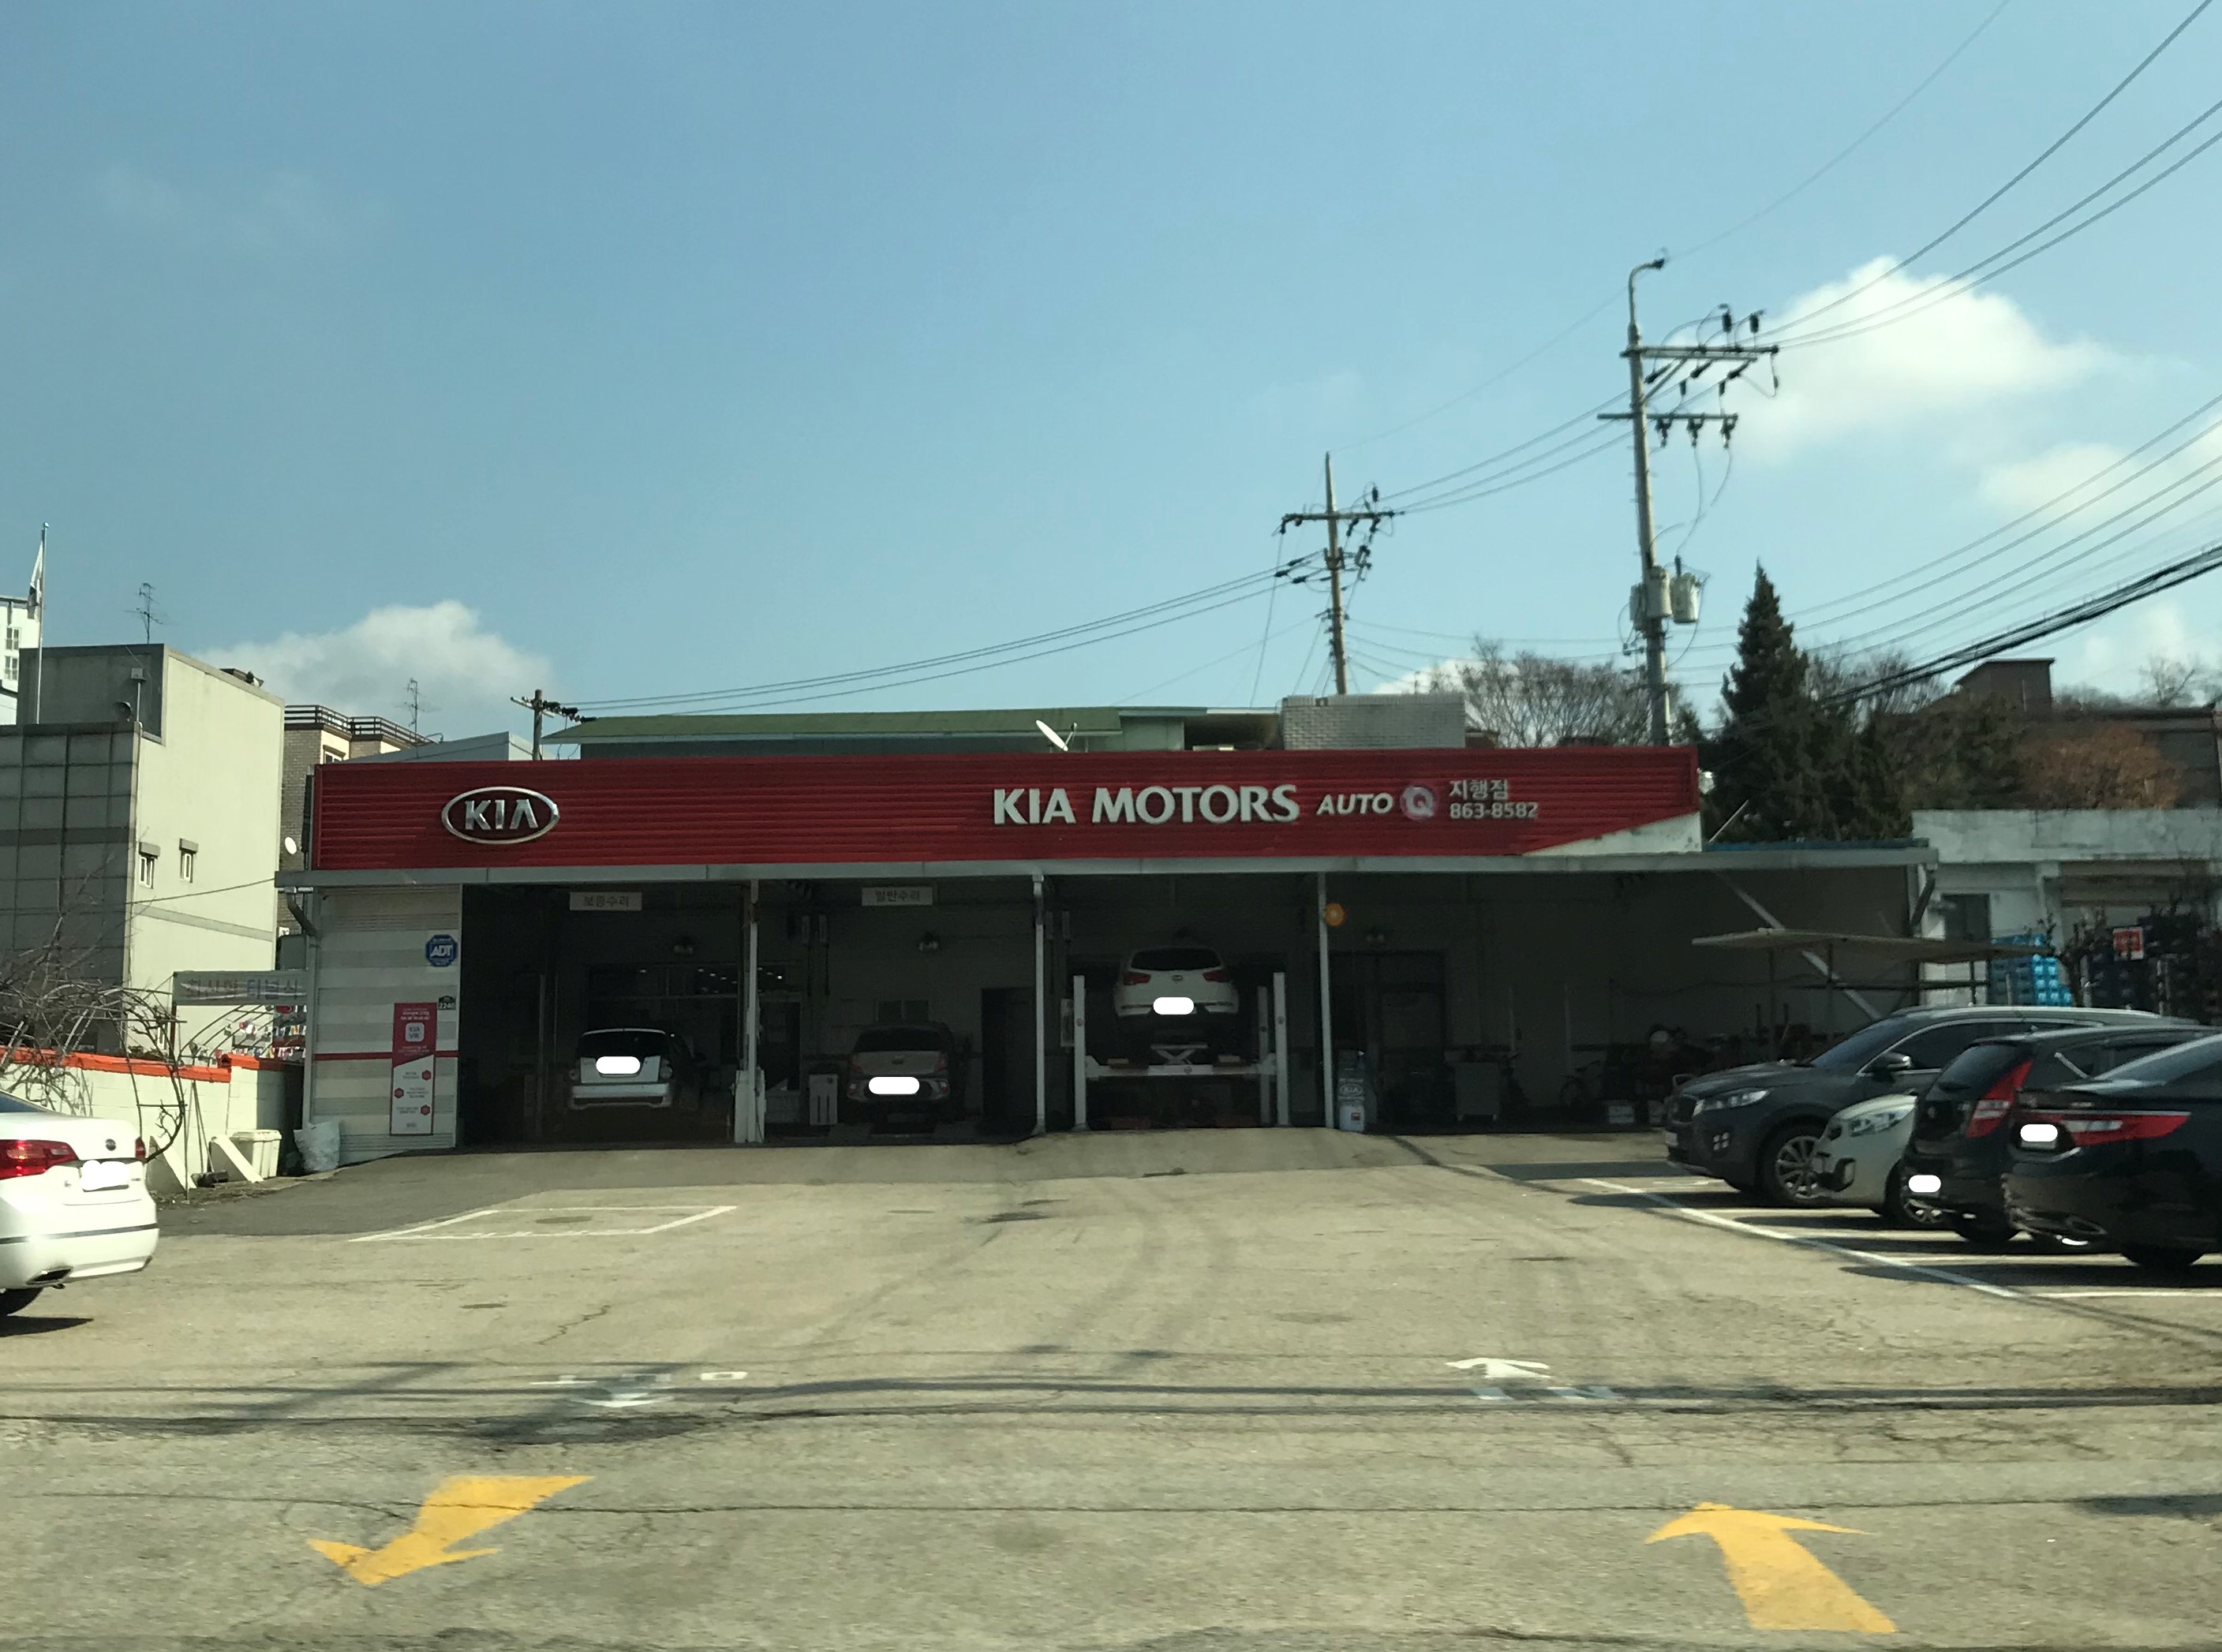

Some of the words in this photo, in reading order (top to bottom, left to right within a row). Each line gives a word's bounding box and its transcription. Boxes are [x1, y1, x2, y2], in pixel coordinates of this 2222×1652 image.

[1449, 778, 1510, 801] 지행점
[465, 798, 539, 831] KIA
[993, 787, 1077, 825] KIA
[1091, 784, 1301, 825] MOTORS
[1315, 792, 1394, 816] AUTO
[1405, 785, 1435, 818] Q
[1449, 802, 1539, 820] 863-8582
[429, 944, 454, 957] ADT
